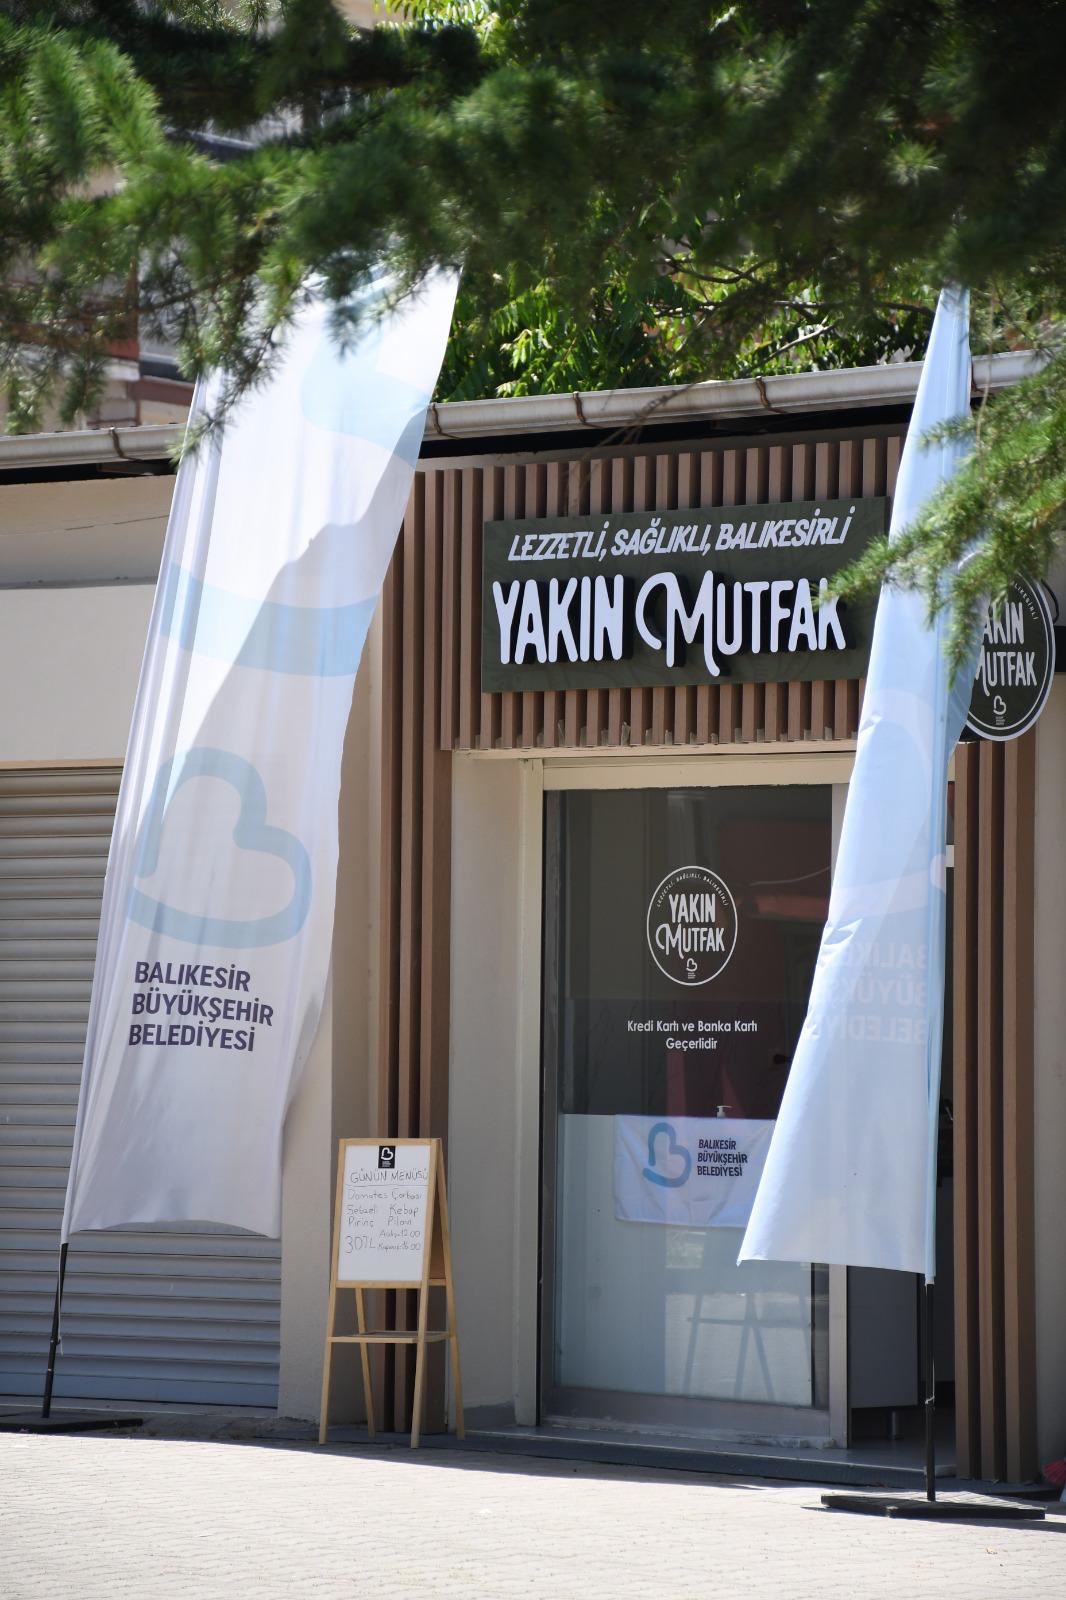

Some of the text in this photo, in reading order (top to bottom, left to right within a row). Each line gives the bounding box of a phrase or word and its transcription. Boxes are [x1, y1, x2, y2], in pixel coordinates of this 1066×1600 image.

[508, 506, 856, 562] LEZZETLİ, SAĞLIKLI, BALIKESİRLİ
[492, 570, 846, 677] YAKIN MUTFAK
[983, 602, 1025, 645] AKIN
[668, 893, 716, 923] YAKIN
[655, 923, 726, 959] MUTFAK
[134, 961, 251, 992] BALIKESİR
[131, 987, 274, 1026] BÜYÜKŞEHİR
[128, 1020, 255, 1051] BELEDİYESİ
[627, 1020, 758, 1032] Kredi Kartı ve Banka Kartı
[665, 1037, 718, 1051] Geçerlidir
[697, 1150, 748, 1166] BÜYÜKŞEHİR
[698, 1137, 737, 1150] BALIKESİR
[350, 1167, 428, 1184] GÜNÜN MENÜSÜ
[697, 1165, 743, 1177] BELEDİYESİ
